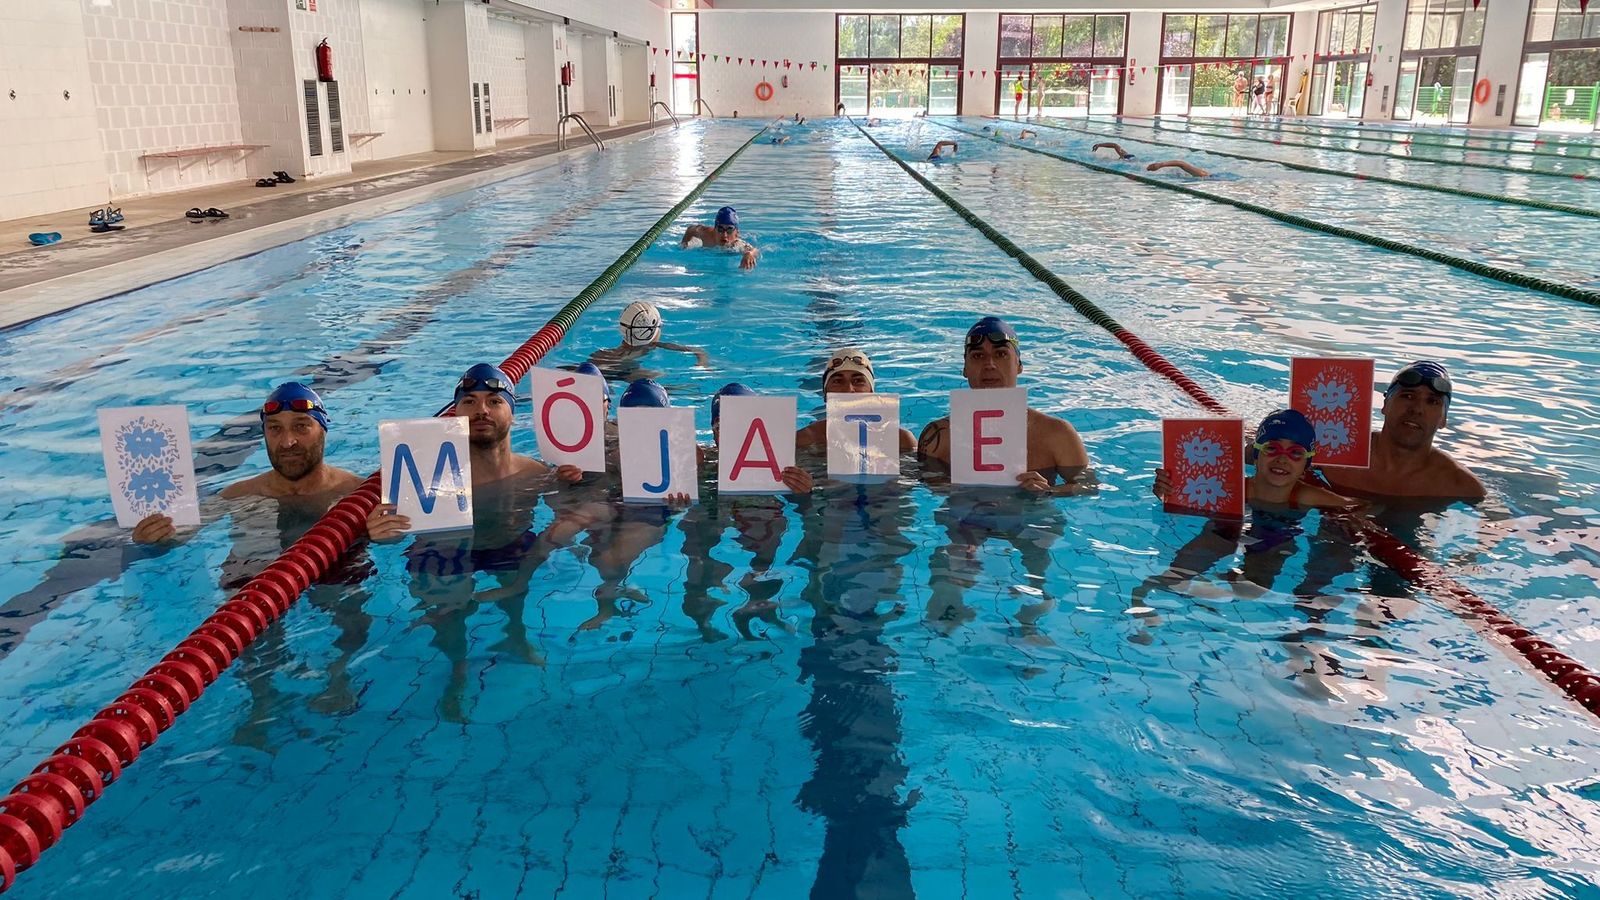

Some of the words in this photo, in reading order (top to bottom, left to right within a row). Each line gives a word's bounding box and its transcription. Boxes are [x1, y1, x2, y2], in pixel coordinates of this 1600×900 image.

[729, 417, 783, 483] A
[973, 409, 1005, 472] E
[389, 441, 468, 514] M
